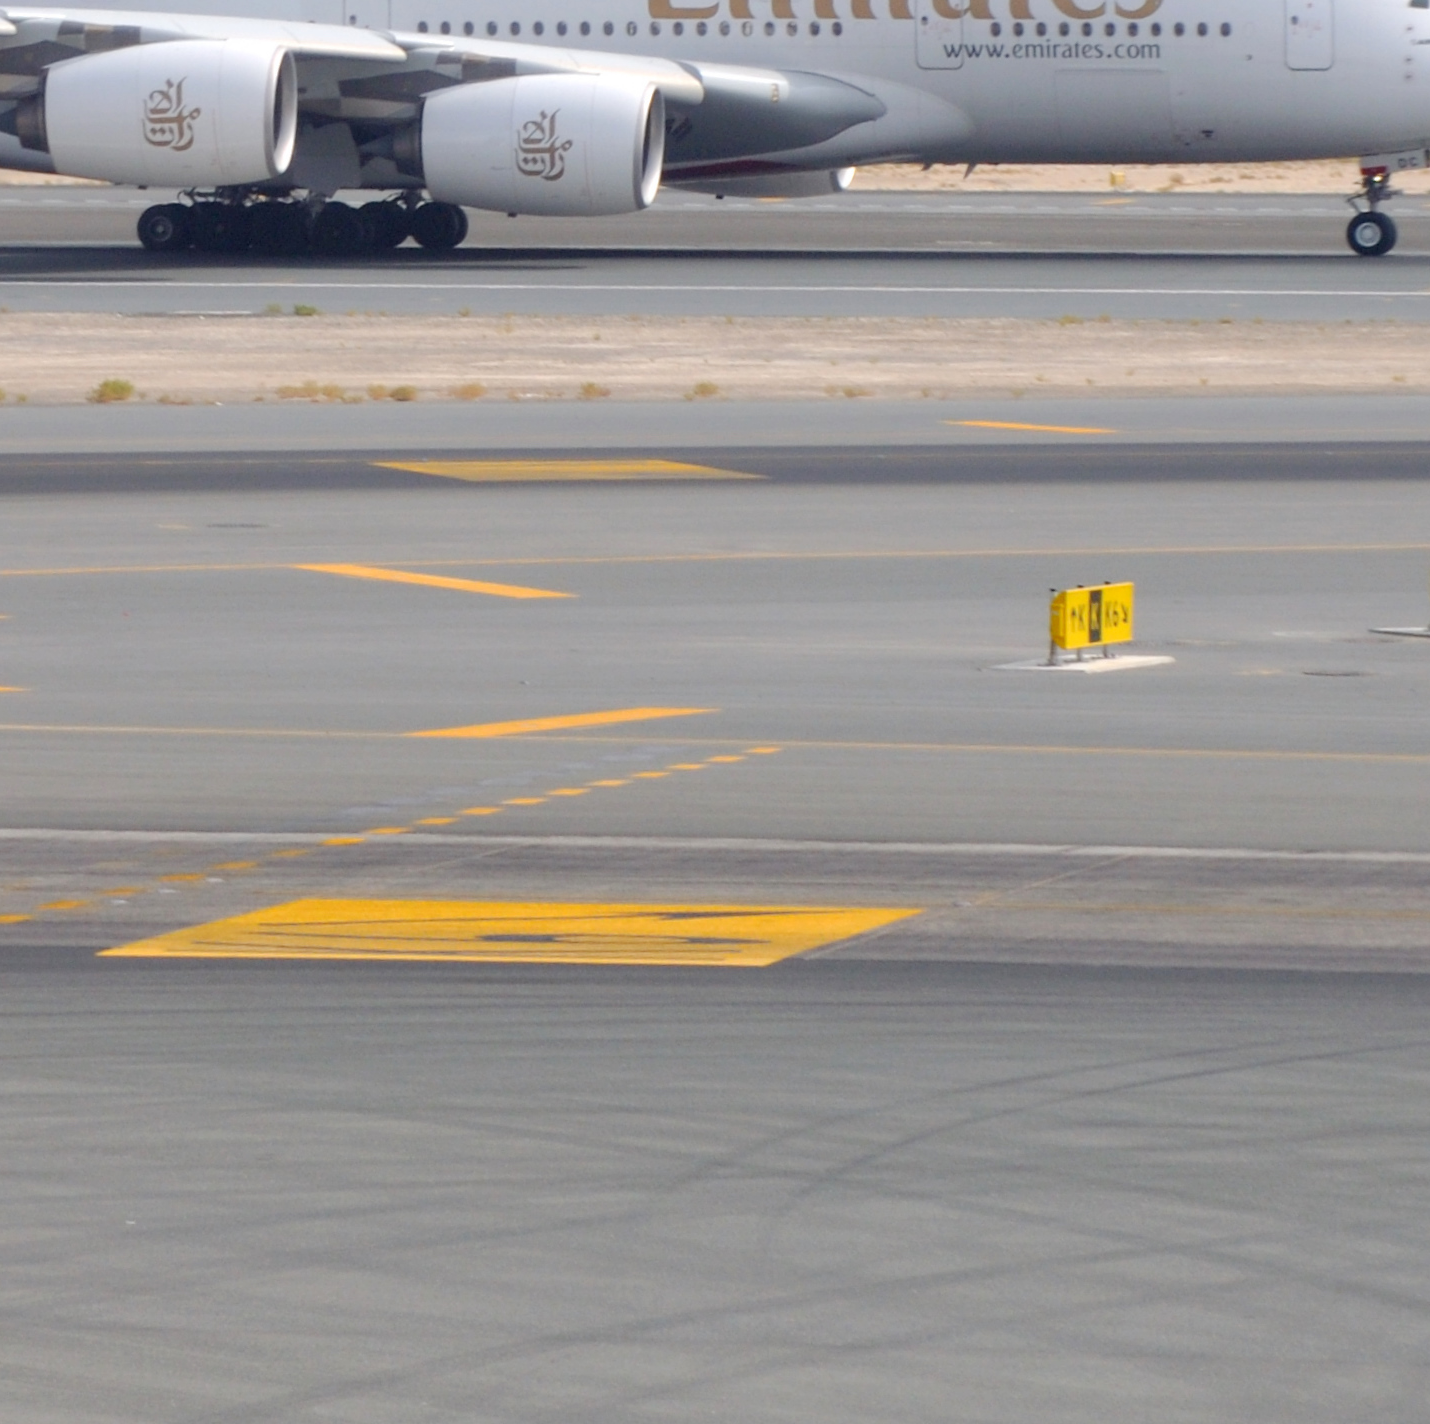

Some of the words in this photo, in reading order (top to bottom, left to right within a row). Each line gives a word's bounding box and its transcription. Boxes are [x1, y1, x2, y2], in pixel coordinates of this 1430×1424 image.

[943, 39, 1162, 60] www.emirates.com
[1397, 156, 1419, 169] DC
[1104, 600, 1119, 629] K6
